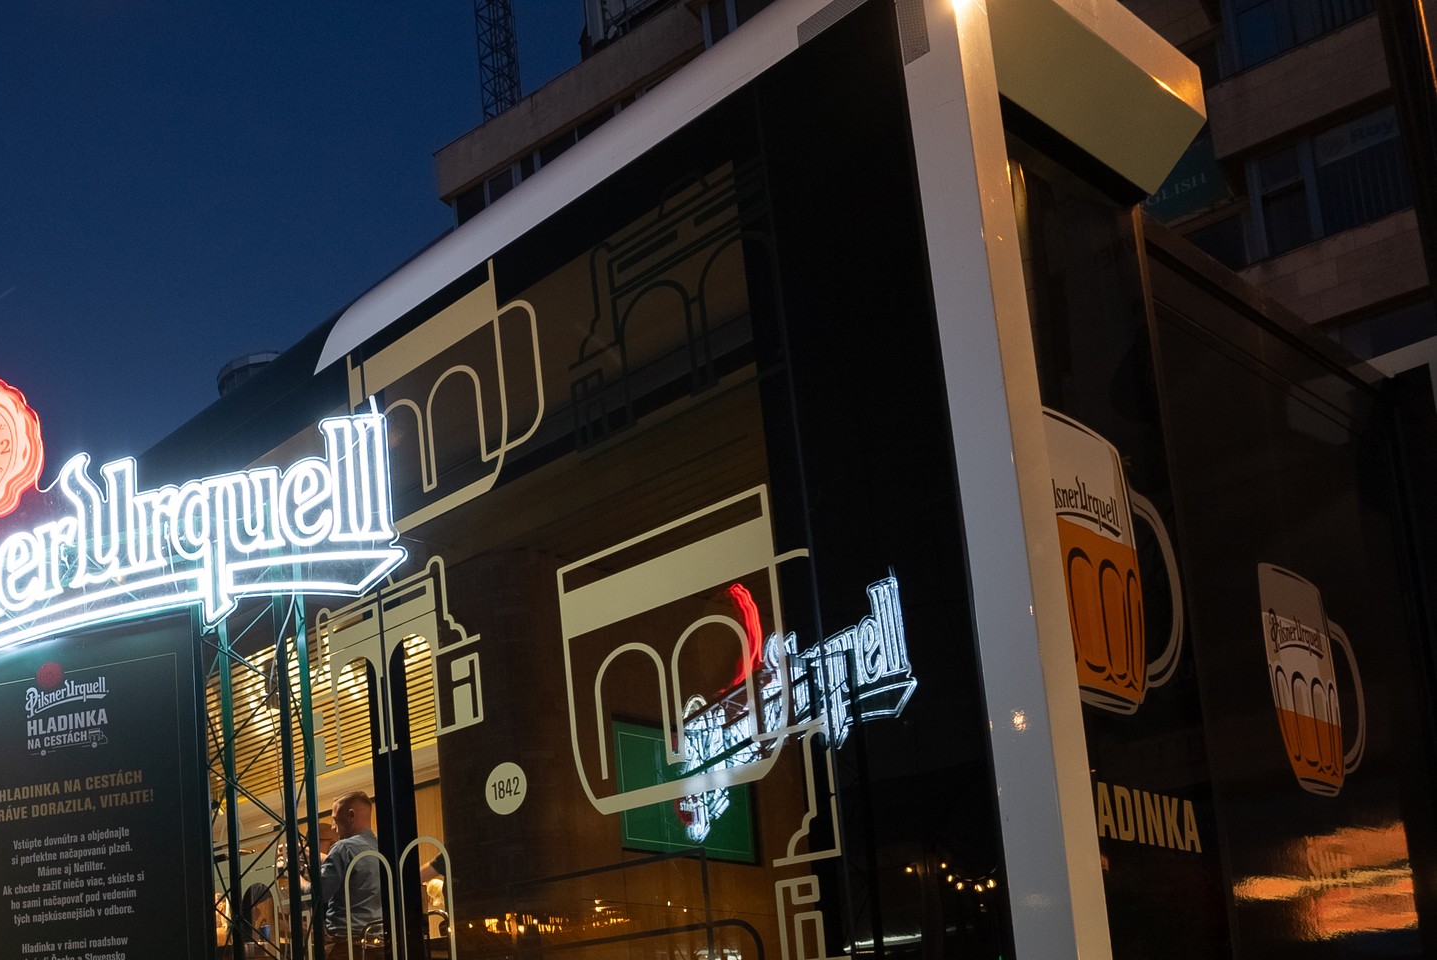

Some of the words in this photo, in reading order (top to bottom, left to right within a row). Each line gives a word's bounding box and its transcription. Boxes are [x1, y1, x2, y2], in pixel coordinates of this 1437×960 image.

[1146, 172, 1206, 205] GLISH
[1051, 478, 1079, 510] lsner
[1075, 475, 1120, 532] Urquell
[59, 412, 396, 628] Urquell
[25, 687, 67, 719] Pilsner
[64, 677, 107, 702] Urquell
[27, 708, 108, 736] HLADINKA
[28, 738, 41, 750] NA
[44, 730, 87, 747] CESTÁCH
[64, 779, 81, 793] NA
[86, 770, 142, 790] CESTÁCH
[492, 776, 520, 800] 1842
[31, 797, 96, 818] DORAZILA,
[100, 788, 154, 809] VITAJTE!
[1097, 781, 1203, 853] ADINKA
[13, 835, 42, 850] Vstúpte
[44, 831, 78, 847] dovnútra
[80, 834, 85, 842] a
[87, 827, 129, 842] objednajte
[11, 855, 18, 865] si
[20, 849, 57, 866] perfektne
[59, 844, 106, 861] načapovanú
[109, 841, 132, 854] plzeň.
[38, 863, 61, 877] Máme
[64, 864, 72, 876] aj
[74, 861, 106, 873] Nefilter.
[3, 885, 12, 896] Ak
[14, 883, 40, 894] chcete
[42, 878, 61, 892] zažiť
[63, 876, 84, 889] niečo
[87, 876, 105, 887] viac,
[107, 872, 135, 885] skúste
[137, 871, 145, 881] si
[11, 899, 20, 910] ho
[22, 897, 41, 908] sami
[43, 893, 84, 908] načapovať
[85, 890, 100, 905] pod
[102, 888, 136, 900] vedením
[14, 910, 31, 926] tých
[32, 906, 95, 924] najskúsenejších
[104, 905, 134, 917] odbore.
[22, 942, 55, 954] Hladinka
[58, 943, 62, 951] v
[64, 938, 87, 950] rámci
[89, 936, 128, 948] roadshow
